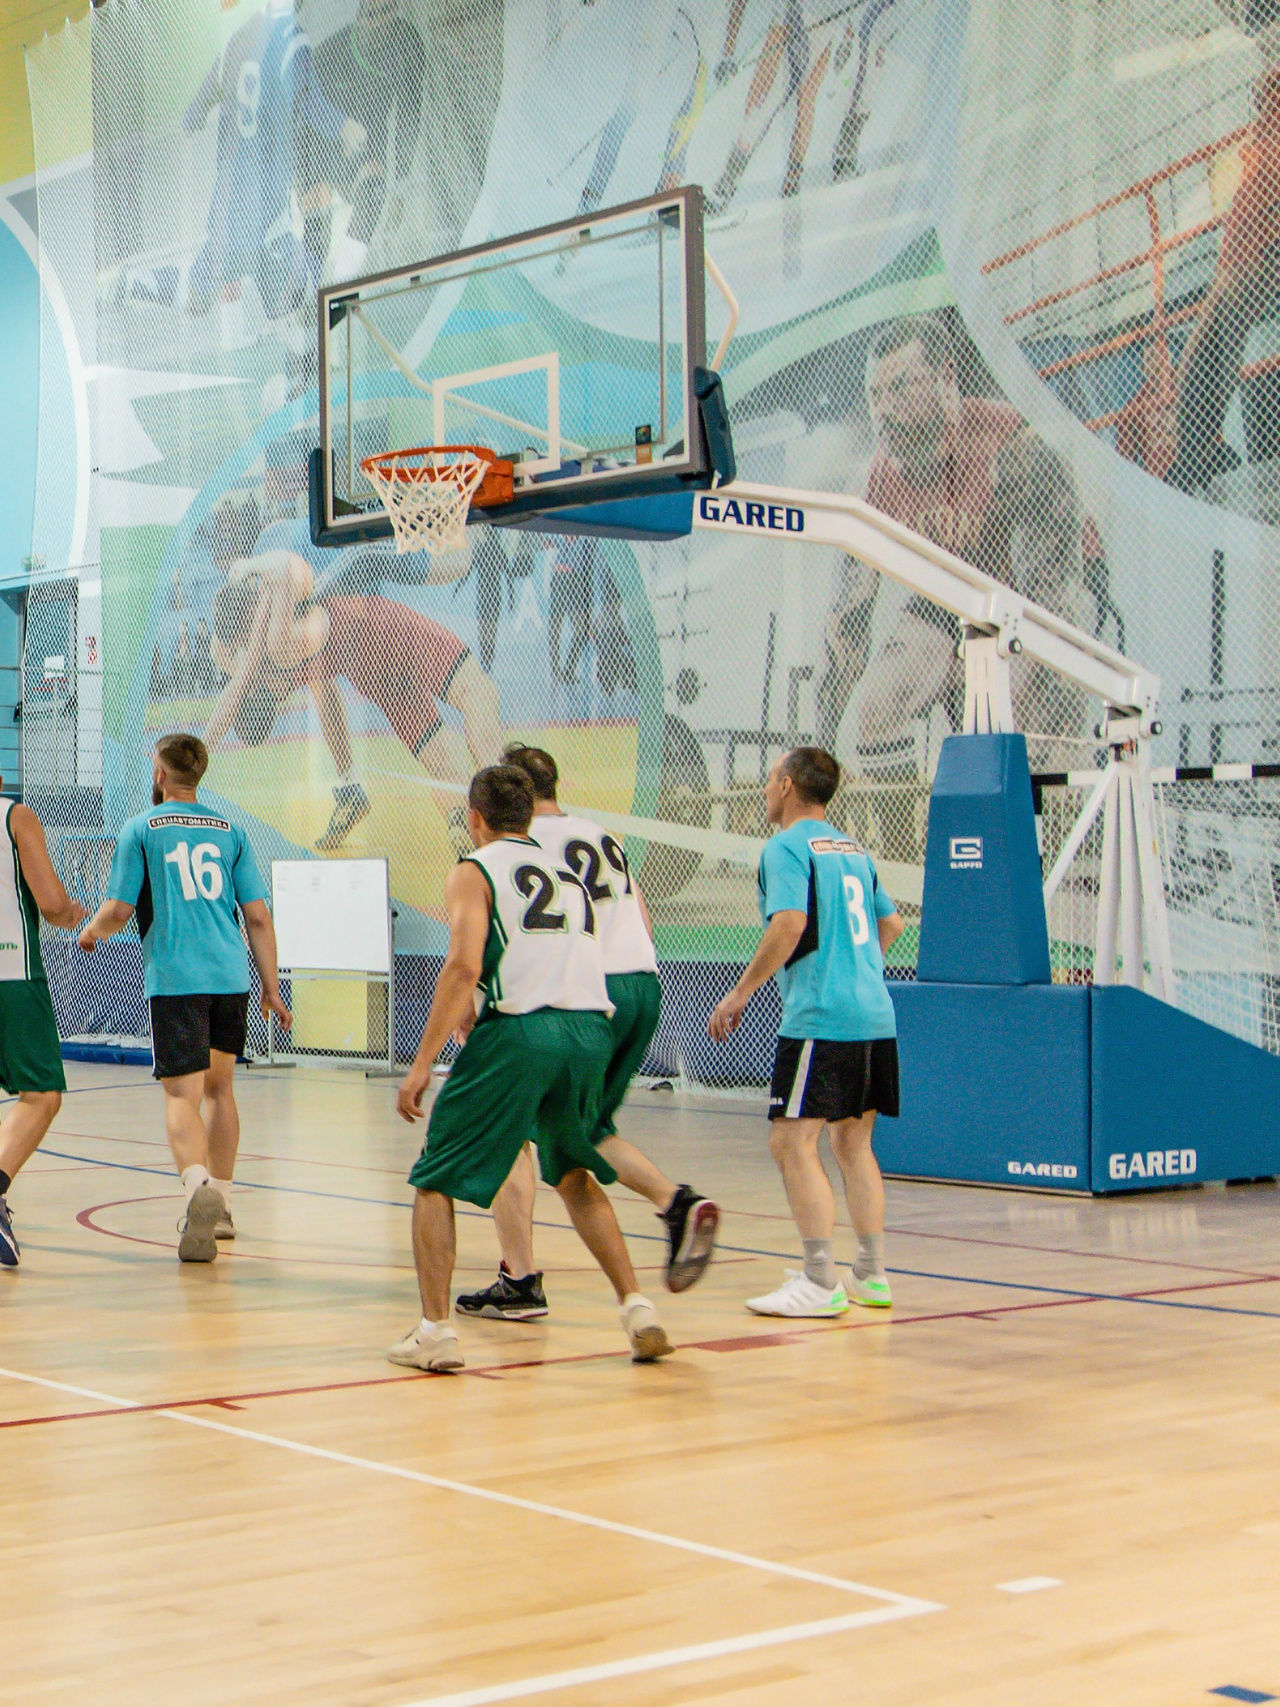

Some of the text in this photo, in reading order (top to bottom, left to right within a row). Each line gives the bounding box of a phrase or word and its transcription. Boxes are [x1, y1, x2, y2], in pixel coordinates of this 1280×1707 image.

[700, 496, 804, 533] GARED
[165, 841, 223, 901] 16
[565, 834, 632, 901] 29
[514, 865, 595, 936] 27
[1007, 1161, 1077, 1179] GARED
[1109, 1149, 1197, 1180] GARED
